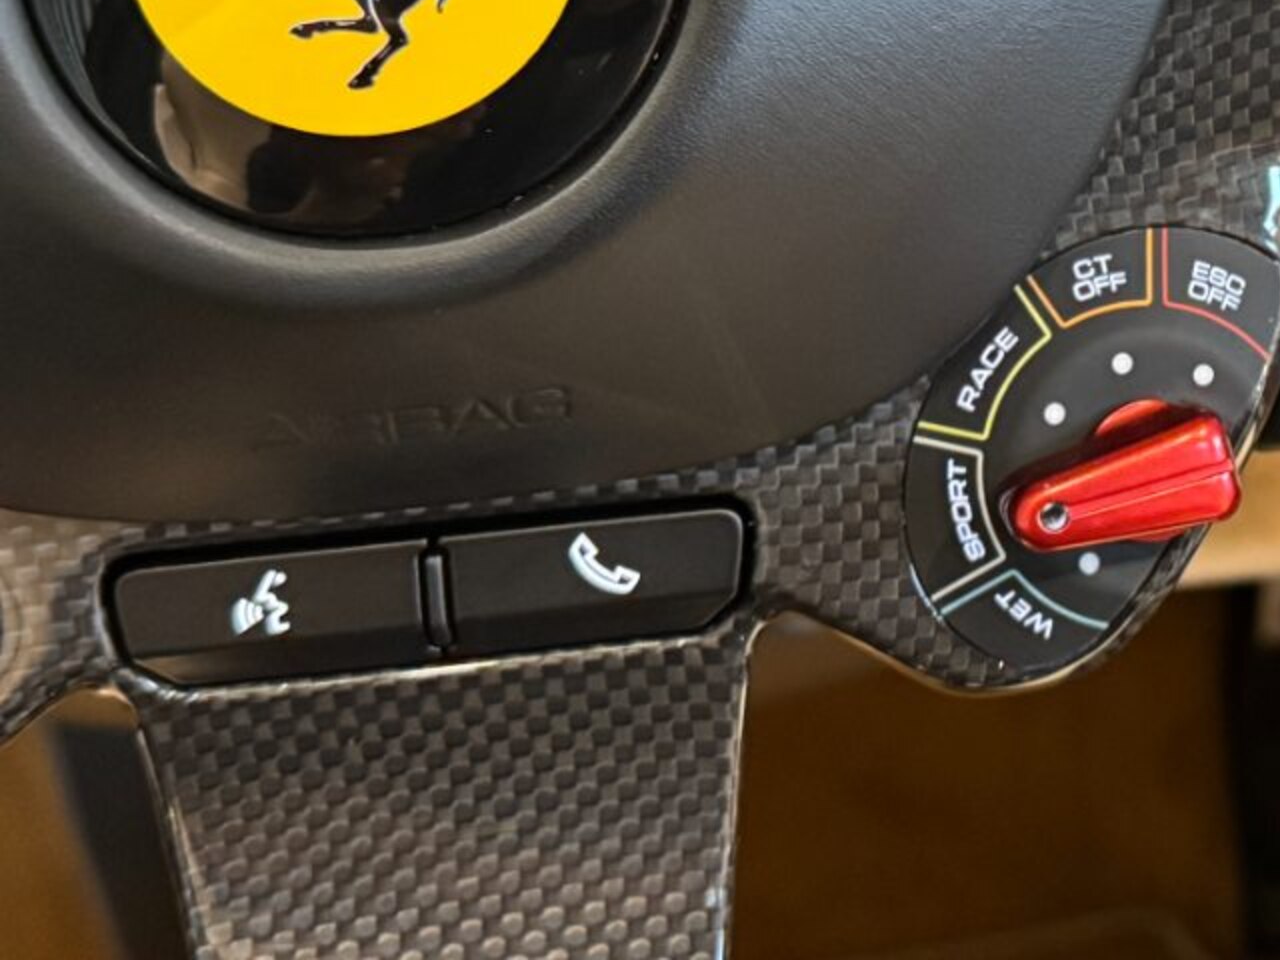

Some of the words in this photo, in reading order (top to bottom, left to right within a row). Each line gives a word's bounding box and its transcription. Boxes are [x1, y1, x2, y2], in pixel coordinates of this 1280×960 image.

[1072, 253, 1113, 280] CT
[1191, 259, 1247, 297] ESC
[1072, 271, 1128, 302] OFF
[1187, 279, 1243, 311] OFF
[956, 326, 1019, 413] RACE
[947, 458, 986, 562] SPORT
[993, 589, 1054, 640] WET
